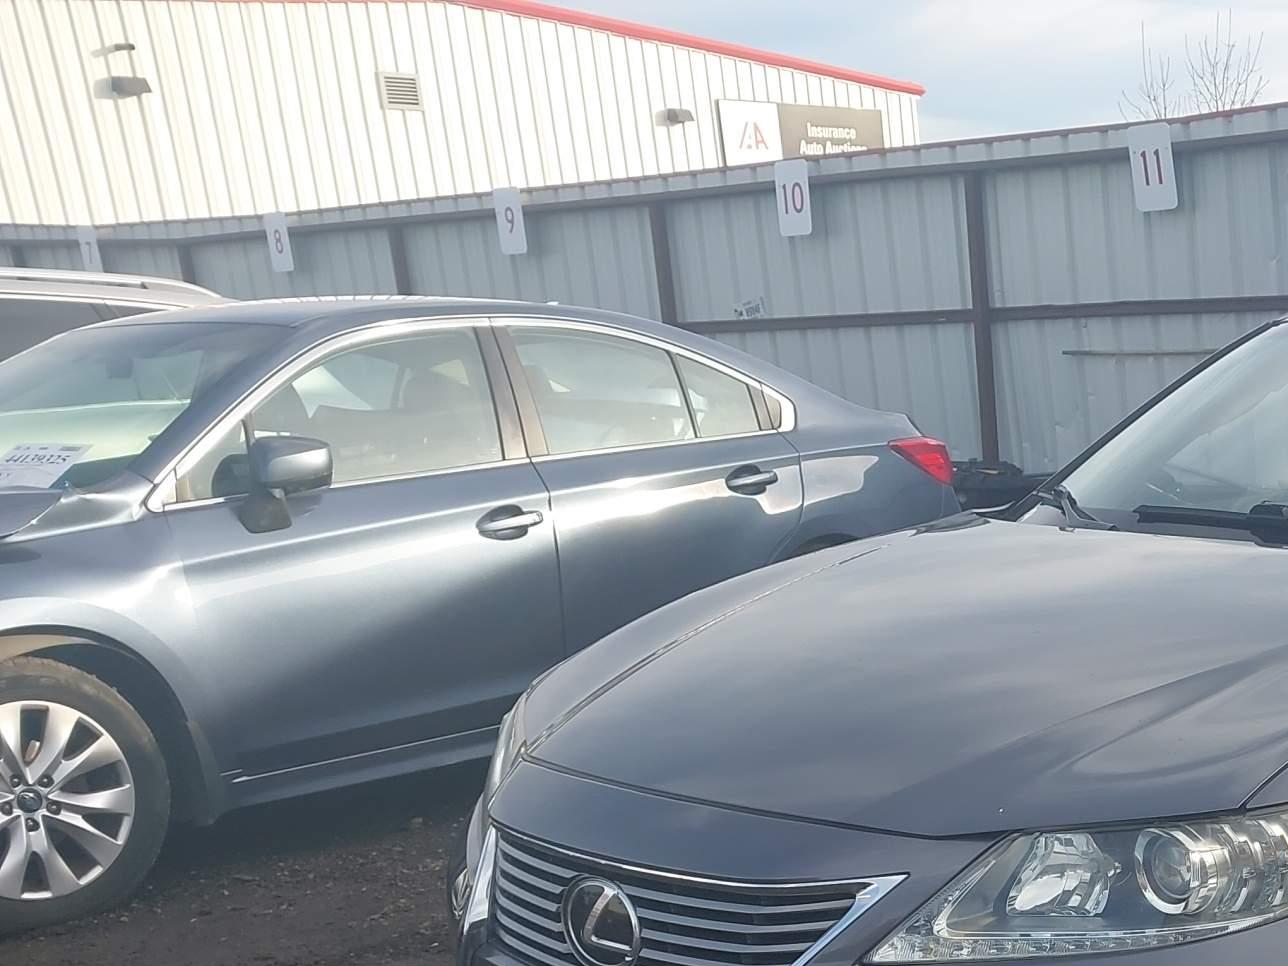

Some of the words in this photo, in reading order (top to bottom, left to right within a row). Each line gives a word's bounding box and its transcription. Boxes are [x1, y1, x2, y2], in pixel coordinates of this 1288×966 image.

[806, 121, 857, 140] Insurance
[799, 139, 825, 156] Auto
[1139, 148, 1164, 187] 11
[781, 181, 805, 215] 10
[504, 206, 515, 234] 9
[85, 241, 94, 265] 7
[273, 229, 284, 254] 8
